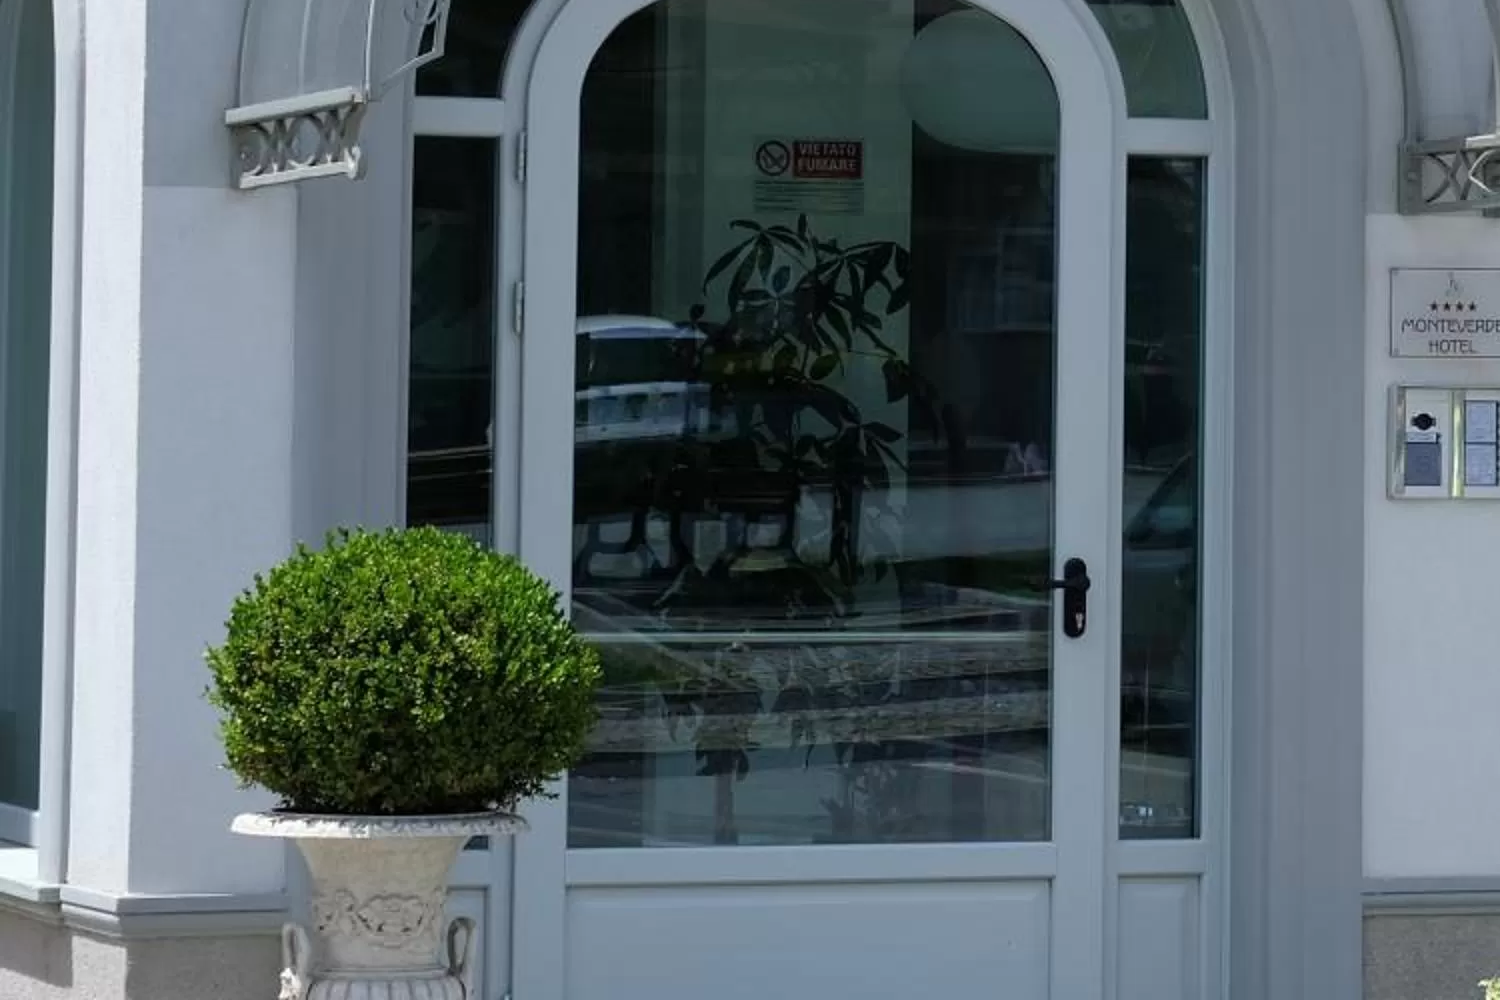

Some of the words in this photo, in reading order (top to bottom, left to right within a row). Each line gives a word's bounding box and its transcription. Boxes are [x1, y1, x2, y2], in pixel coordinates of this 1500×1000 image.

[799, 143, 856, 156] VIETATO
[797, 157, 857, 171] FUMARE
[1428, 339, 1476, 354] HOTEL
